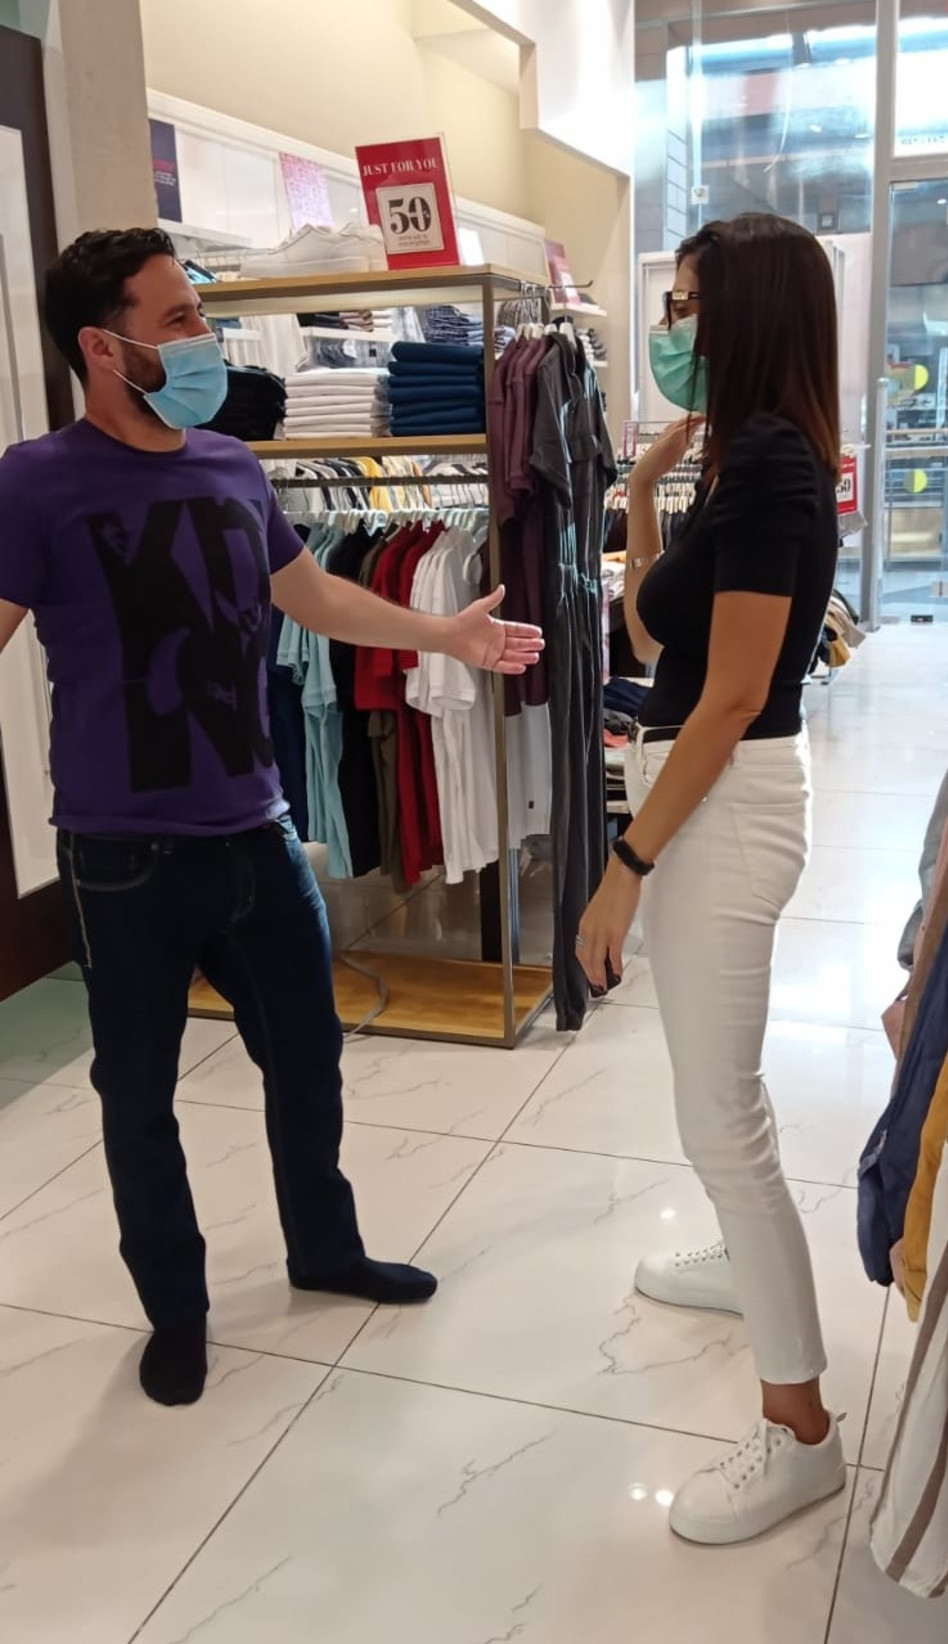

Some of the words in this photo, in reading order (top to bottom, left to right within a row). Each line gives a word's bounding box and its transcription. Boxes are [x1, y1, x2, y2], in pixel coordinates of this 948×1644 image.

[362, 164, 388, 177] JUST
[391, 160, 414, 173] FOR
[416, 157, 438, 170] YOU
[388, 196, 432, 235] 50
